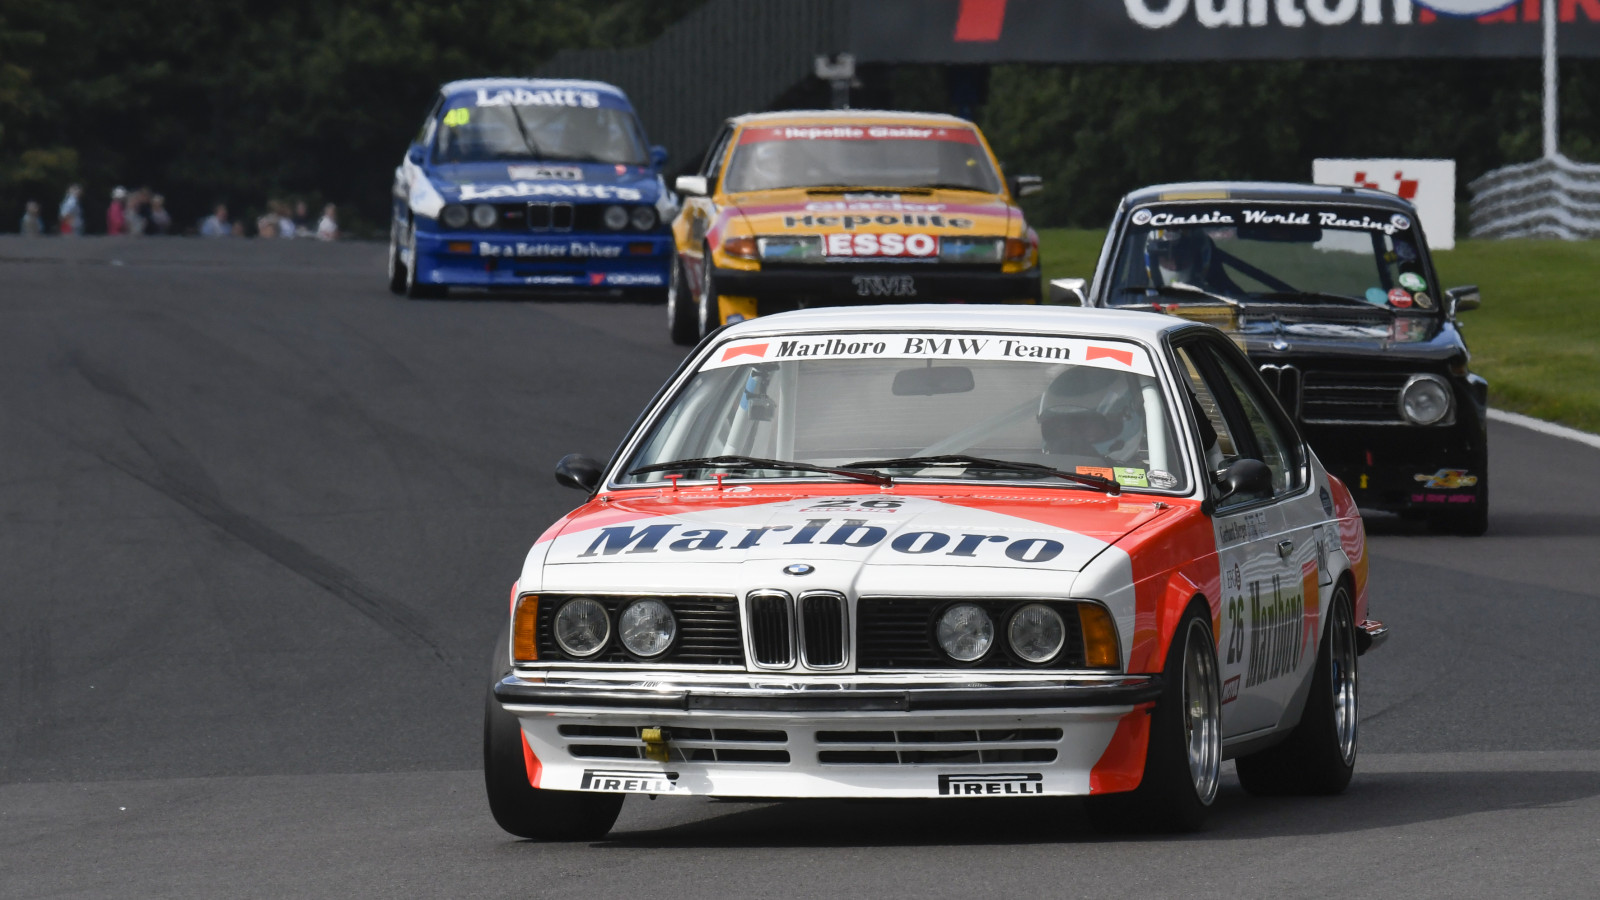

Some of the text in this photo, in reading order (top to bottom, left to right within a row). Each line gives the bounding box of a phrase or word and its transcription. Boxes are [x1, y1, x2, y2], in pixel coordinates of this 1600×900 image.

[476, 88, 600, 108] Labatt's
[444, 108, 469, 126] 40
[785, 127, 933, 139] Hepolite Glacier
[459, 182, 642, 200] Labatt's
[805, 201, 947, 213] Glacier
[783, 213, 973, 230] Hepolite
[1150, 210, 1398, 235] Classic World Racing
[479, 241, 621, 257] Be a Better Driver
[828, 234, 937, 256] ESSO
[852, 275, 917, 296] TWR
[775, 336, 1071, 361] Marlboro BMW Team
[808, 500, 906, 509] 26
[577, 518, 1065, 563] Marlboro
[1227, 595, 1245, 665] 26
[1245, 573, 1303, 689] Marlboro
[938, 772, 1043, 795] PIRELLI
